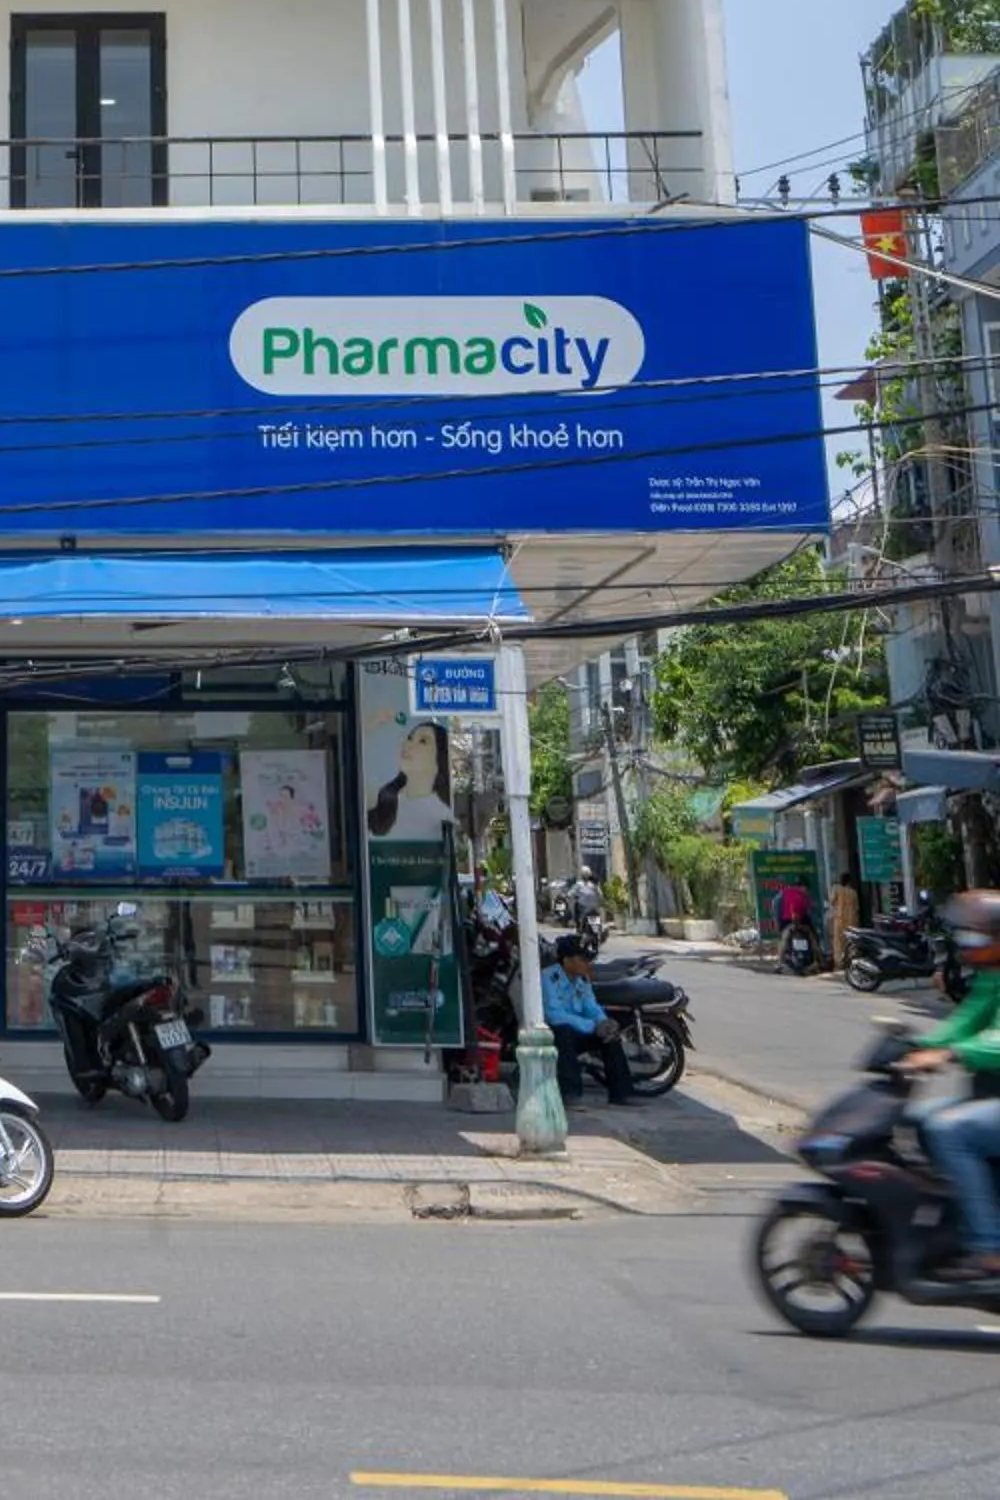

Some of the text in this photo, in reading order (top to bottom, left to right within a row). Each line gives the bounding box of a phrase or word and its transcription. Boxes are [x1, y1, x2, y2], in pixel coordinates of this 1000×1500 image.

[262, 326, 611, 389] Pharmacity
[305, 423, 363, 453] kiệm
[372, 424, 417, 449] hơn
[440, 422, 501, 453] Sống
[577, 423, 623, 448] hơn
